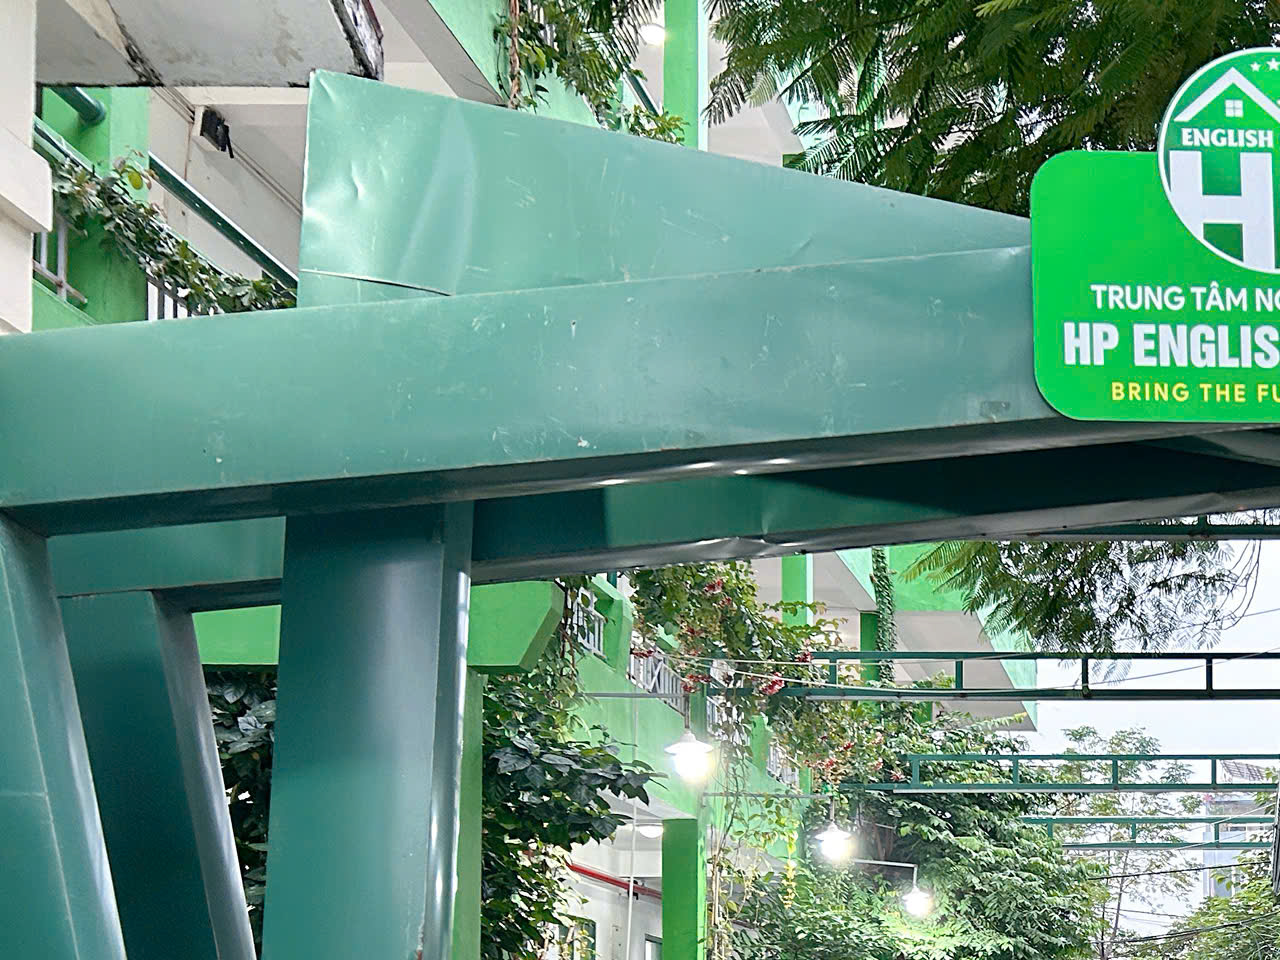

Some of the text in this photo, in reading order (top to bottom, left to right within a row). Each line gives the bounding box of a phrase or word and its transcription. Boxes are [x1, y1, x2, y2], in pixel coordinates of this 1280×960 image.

[1181, 128, 1274, 148] ENGLISH
[1090, 284, 1185, 310] TRUNG
[1190, 281, 1247, 312] TÂM
[1064, 322, 1119, 366] HP
[1111, 382, 1190, 402] BRING
[1200, 384, 1246, 403] THE
